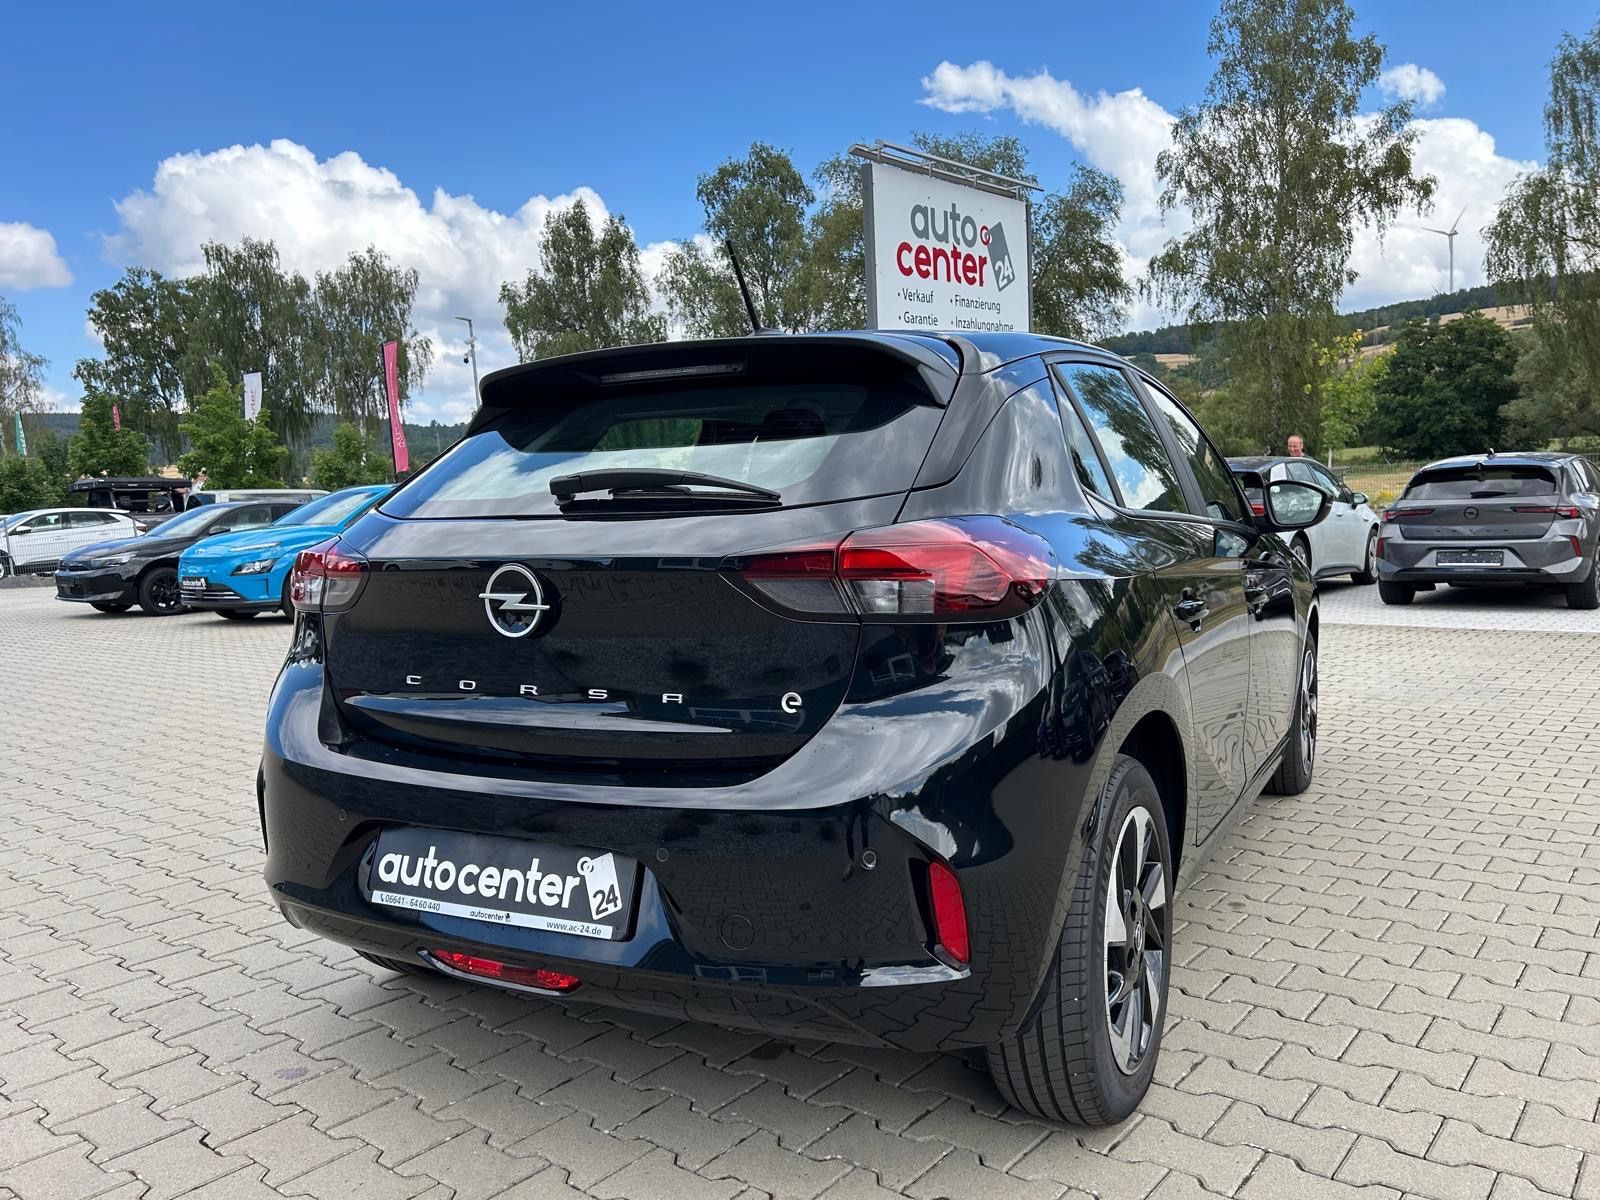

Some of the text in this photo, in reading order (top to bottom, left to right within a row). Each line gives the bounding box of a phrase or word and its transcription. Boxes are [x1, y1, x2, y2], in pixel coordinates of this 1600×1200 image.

[911, 203, 978, 248] auto
[896, 242, 988, 287] center
[994, 256, 1014, 286] 24
[902, 288, 934, 304] Verkauf
[955, 294, 1001, 315] Finanzierung
[903, 311, 938, 326] Garantie
[406, 674, 683, 705] CORSA
[378, 845, 580, 908] autocenter
[592, 884, 619, 916] 24
[469, 910, 505, 921] autocenter
[546, 921, 602, 936] www.ac-24.de
